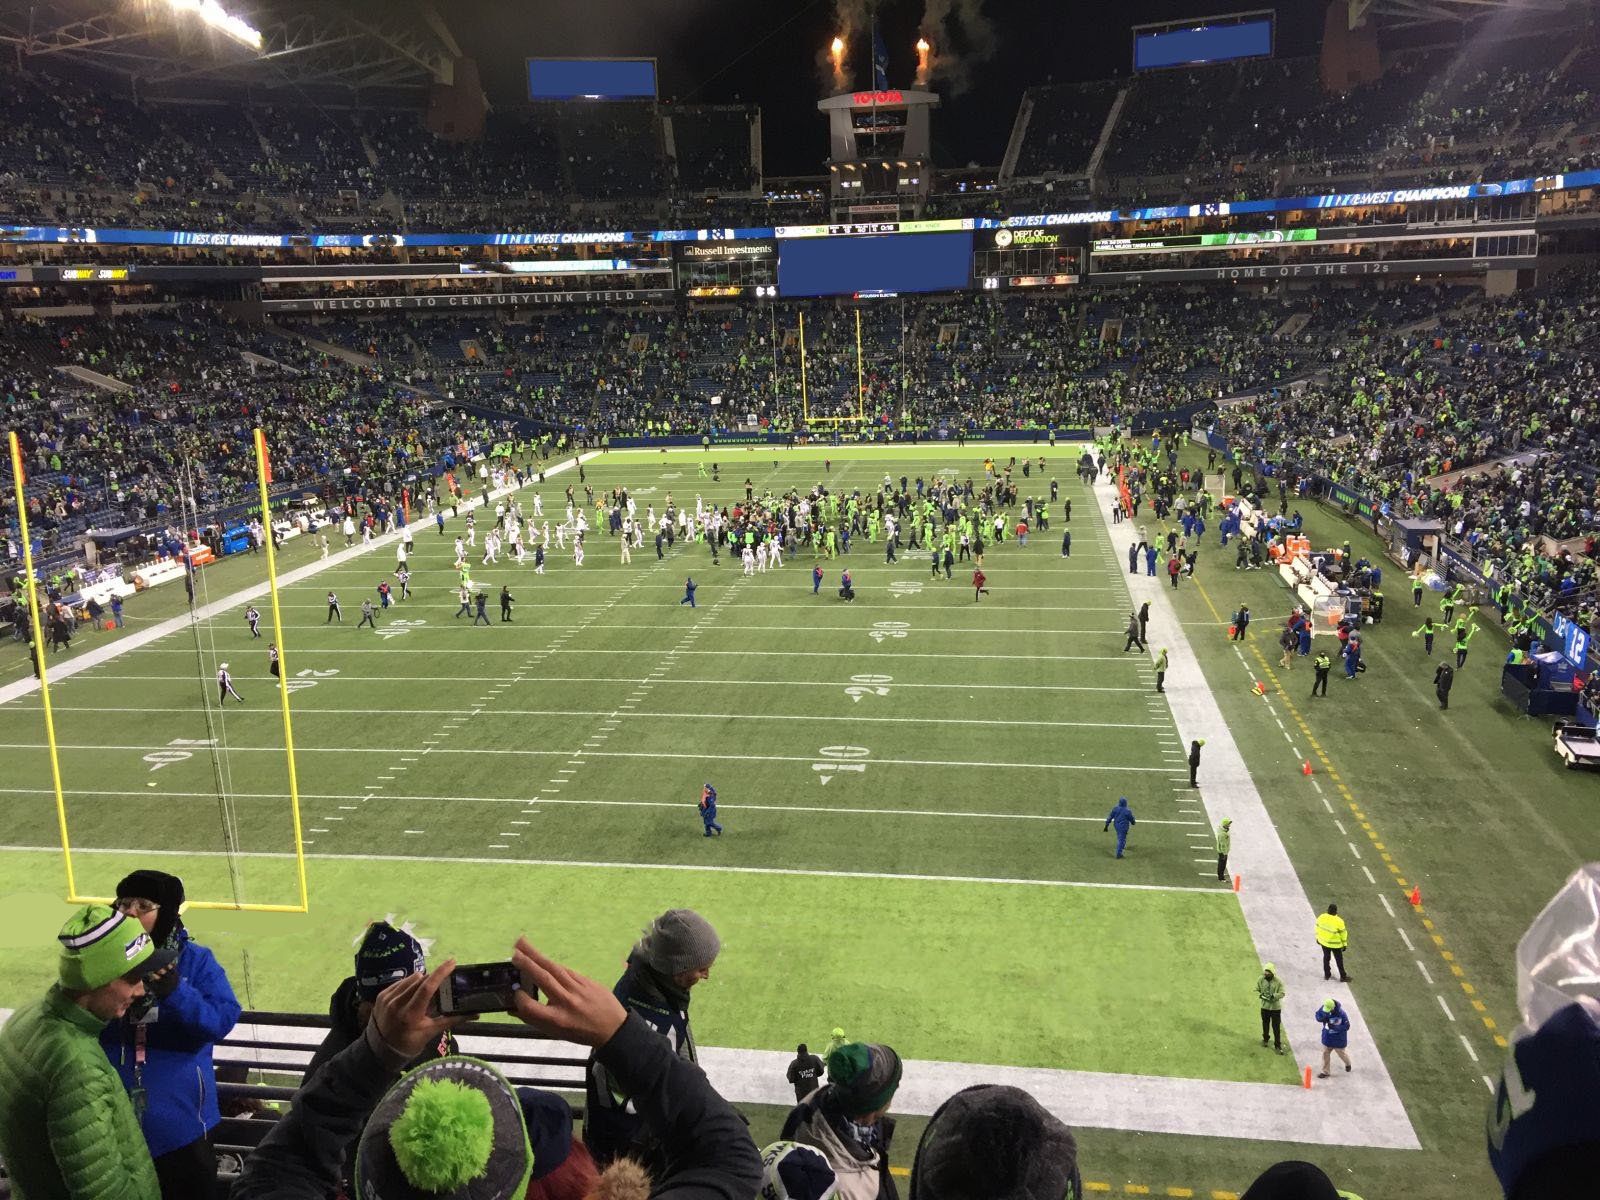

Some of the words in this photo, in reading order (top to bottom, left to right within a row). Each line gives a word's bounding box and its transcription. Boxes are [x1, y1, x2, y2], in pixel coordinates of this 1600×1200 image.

[1394, 185, 1471, 202] CHAMPIONS
[1046, 211, 1112, 225] CHAMPIONS
[230, 234, 283, 246] CHAMPIONS
[561, 232, 625, 243] CHAMPIONS
[1013, 230, 1033, 238] DEPT
[694, 246, 722, 256] Russell
[723, 244, 772, 255] Investments
[62, 269, 95, 279] SUBWAY
[98, 269, 128, 279] SUBWAY
[1217, 268, 1268, 279] HOME
[1280, 267, 1301, 277] OF
[1314, 264, 1348, 275] THE
[1362, 263, 1390, 274] 12s
[313, 297, 403, 310] WELCOME
[416, 297, 436, 307] TO
[449, 292, 575, 307] CENTURYLINK
[586, 291, 635, 302] FIELD
[888, 581, 924, 594] 40
[374, 619, 427, 635] 30
[868, 621, 911, 638] 30
[1569, 627, 1586, 665] 12
[844, 674, 894, 696] 20
[142, 738, 219, 764] 10
[811, 745, 871, 773] 10
